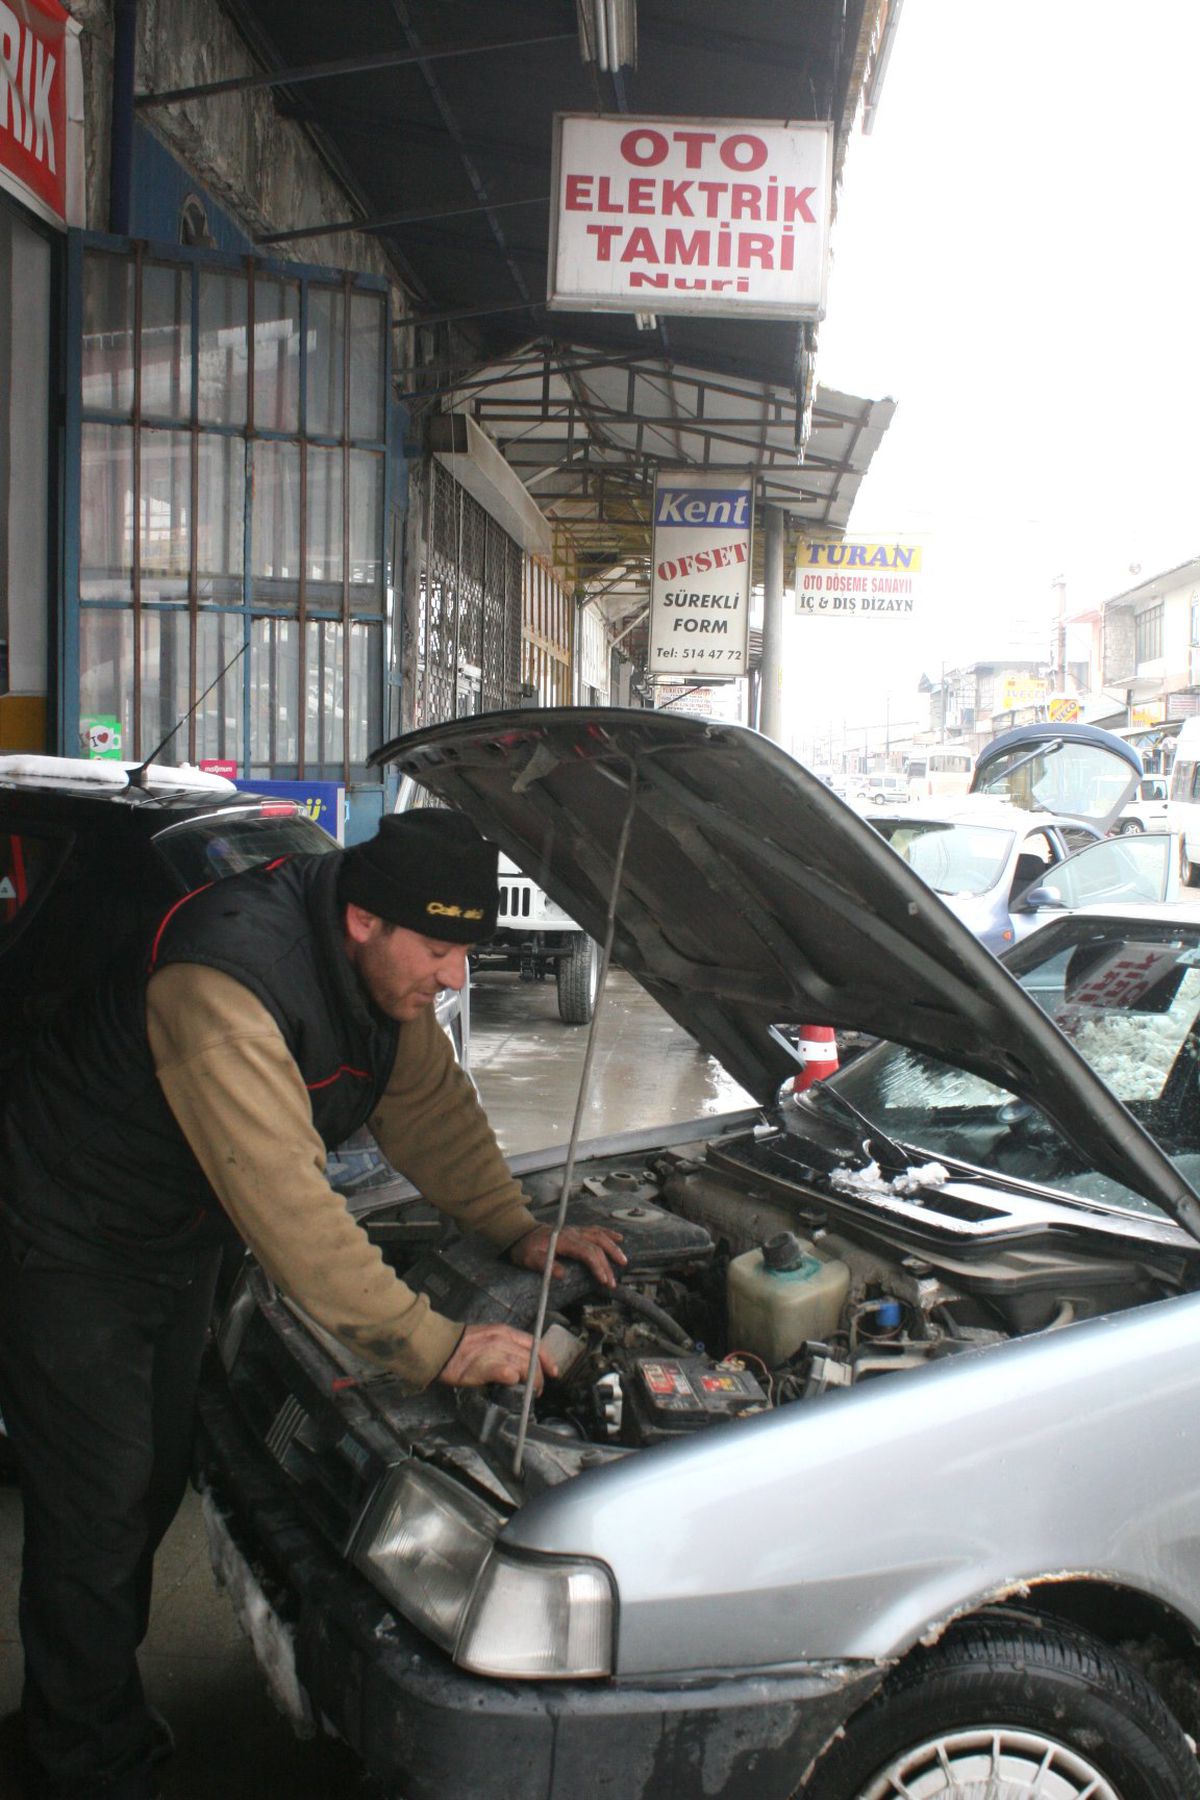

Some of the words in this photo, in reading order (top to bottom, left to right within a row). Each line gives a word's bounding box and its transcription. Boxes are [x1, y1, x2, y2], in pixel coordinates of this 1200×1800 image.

[620, 129, 768, 172] OTO
[565, 174, 817, 223] ELEKTRİK
[586, 221, 796, 271] TAMİRİ
[629, 272, 750, 293] Nuri
[658, 493, 748, 524] Kent
[657, 542, 749, 581] OFSET
[806, 543, 915, 568] TURAN
[803, 574, 823, 591] OTO
[663, 589, 740, 609] SÜREKLİ
[818, 596, 829, 609] &
[861, 595, 914, 612] DİZAYN
[673, 618, 728, 634] FORM
[657, 647, 678, 658] Tel:
[682, 648, 705, 659] 514
[708, 649, 724, 659] 47
[727, 650, 742, 661] 72
